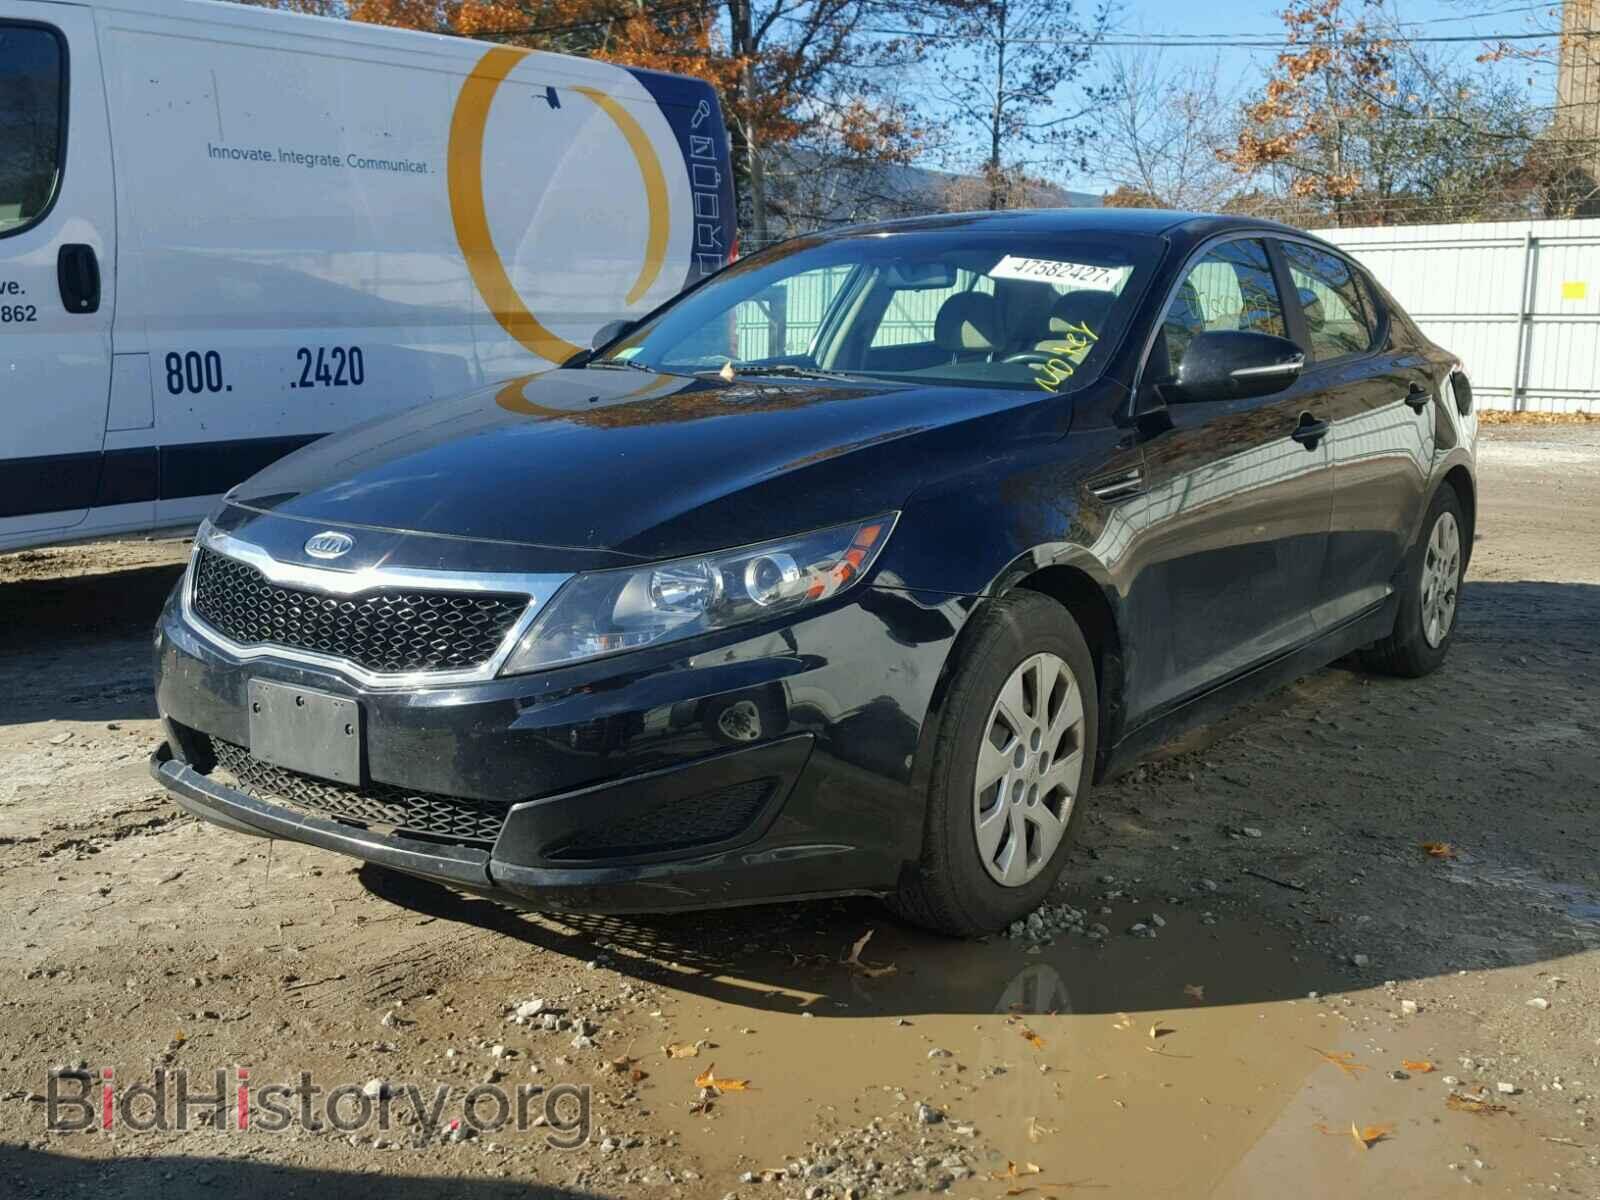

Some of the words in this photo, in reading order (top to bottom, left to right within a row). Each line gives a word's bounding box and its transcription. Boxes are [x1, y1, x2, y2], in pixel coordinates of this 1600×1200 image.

[207, 143, 276, 162] Innovate.
[278, 147, 344, 168] Integrate.
[1, 304, 38, 322] 862
[165, 350, 233, 395] 800.
[290, 346, 365, 389] .2420
